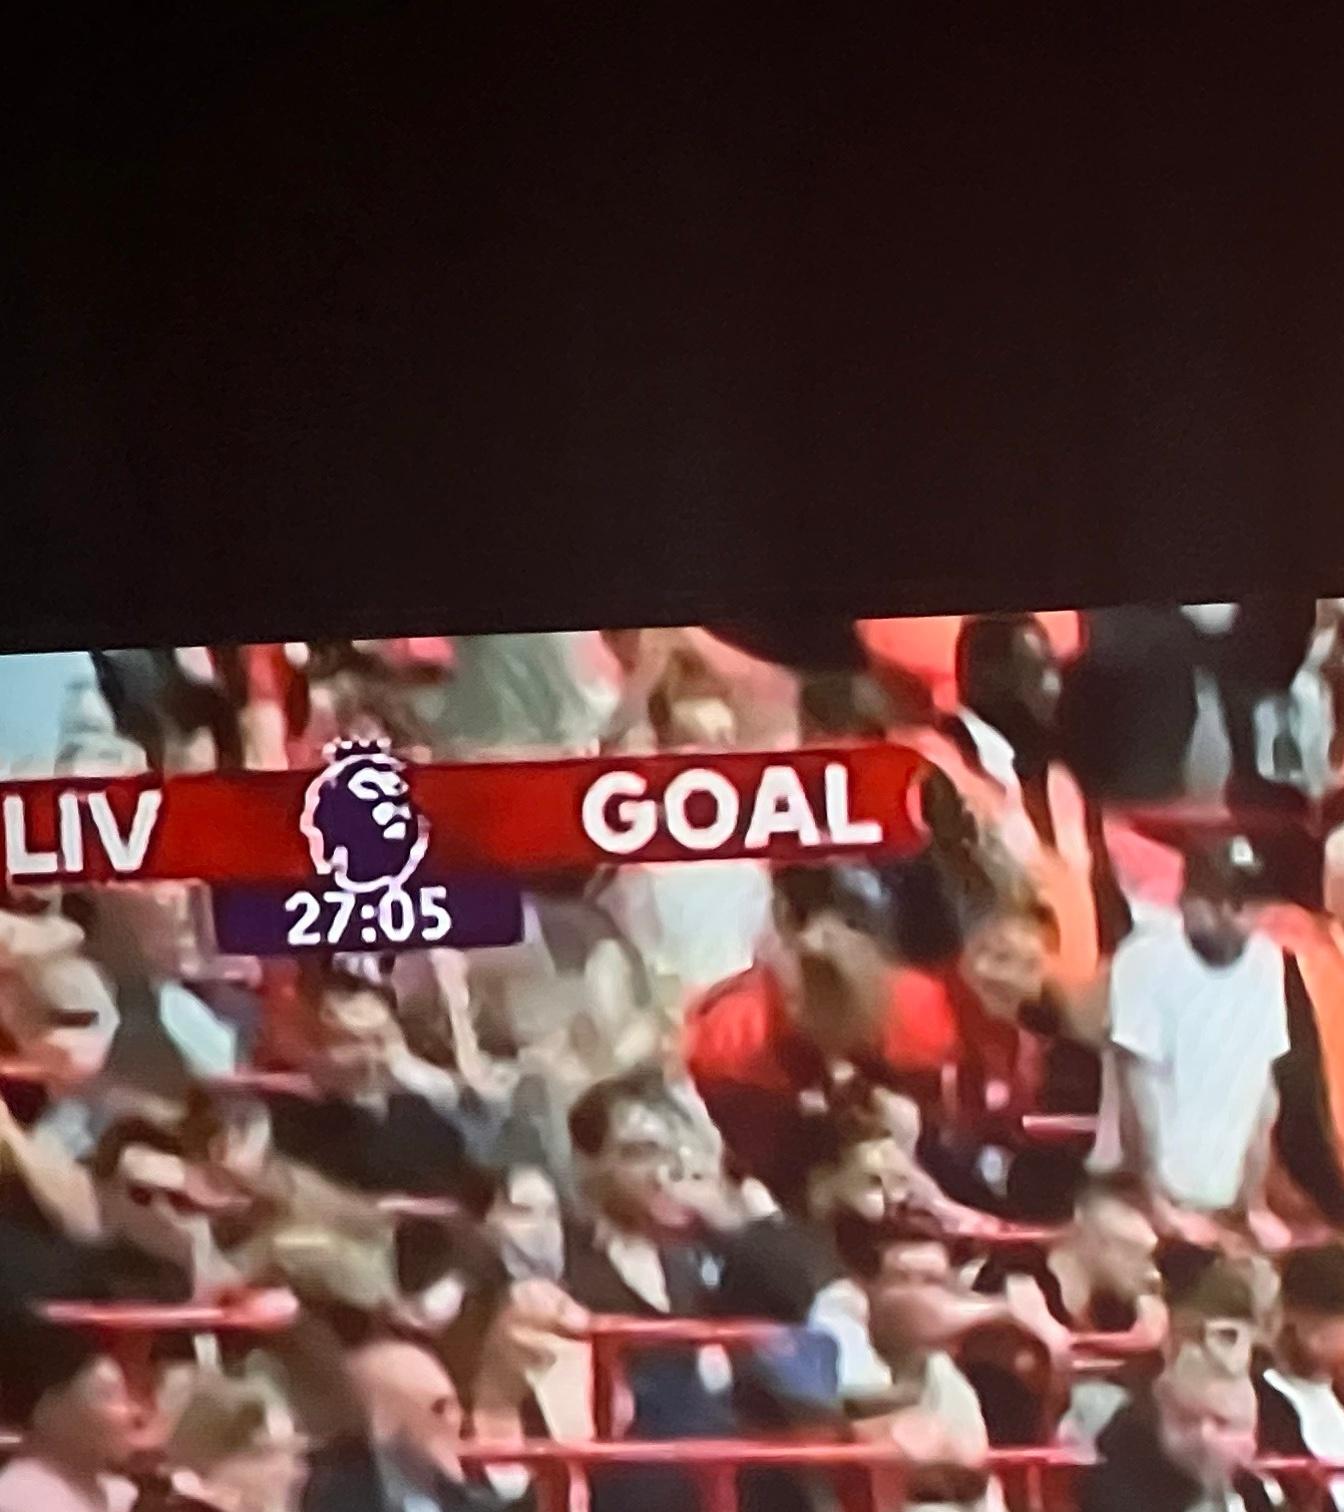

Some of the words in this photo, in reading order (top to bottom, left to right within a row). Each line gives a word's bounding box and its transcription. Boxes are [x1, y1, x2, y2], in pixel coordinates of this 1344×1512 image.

[3, 789, 163, 875] LIV
[581, 764, 883, 856] GOAL
[285, 886, 453, 947] 27:05
